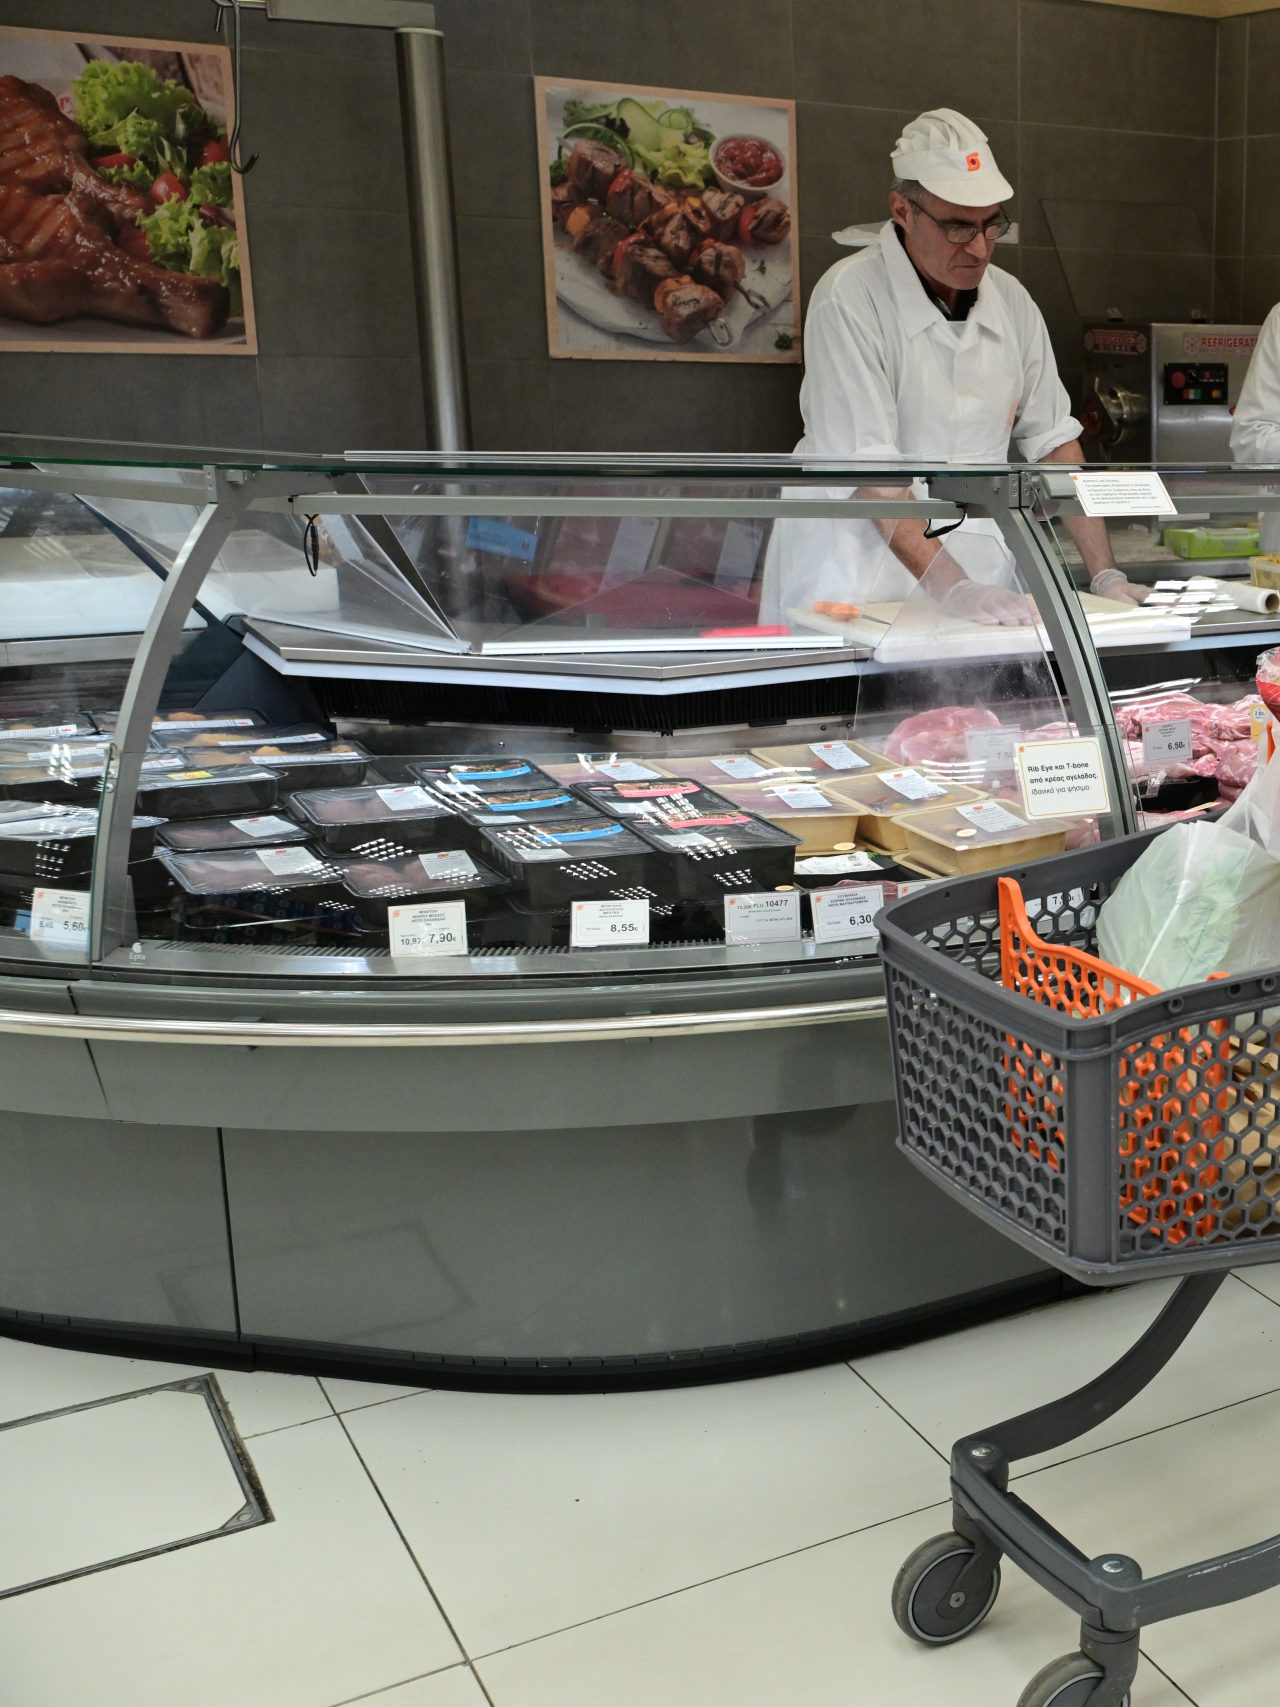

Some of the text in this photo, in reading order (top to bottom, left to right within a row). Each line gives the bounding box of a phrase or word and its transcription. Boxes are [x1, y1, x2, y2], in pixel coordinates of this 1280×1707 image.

[1201, 337, 1258, 348] REFRIGERAT
[1041, 765, 1054, 773] Eye
[1066, 762, 1089, 770] T-bone
[1030, 776, 1043, 784] από
[1044, 775, 1065, 784] κρέας
[765, 900, 789, 908] 10477
[850, 914, 872, 926] 6,30
